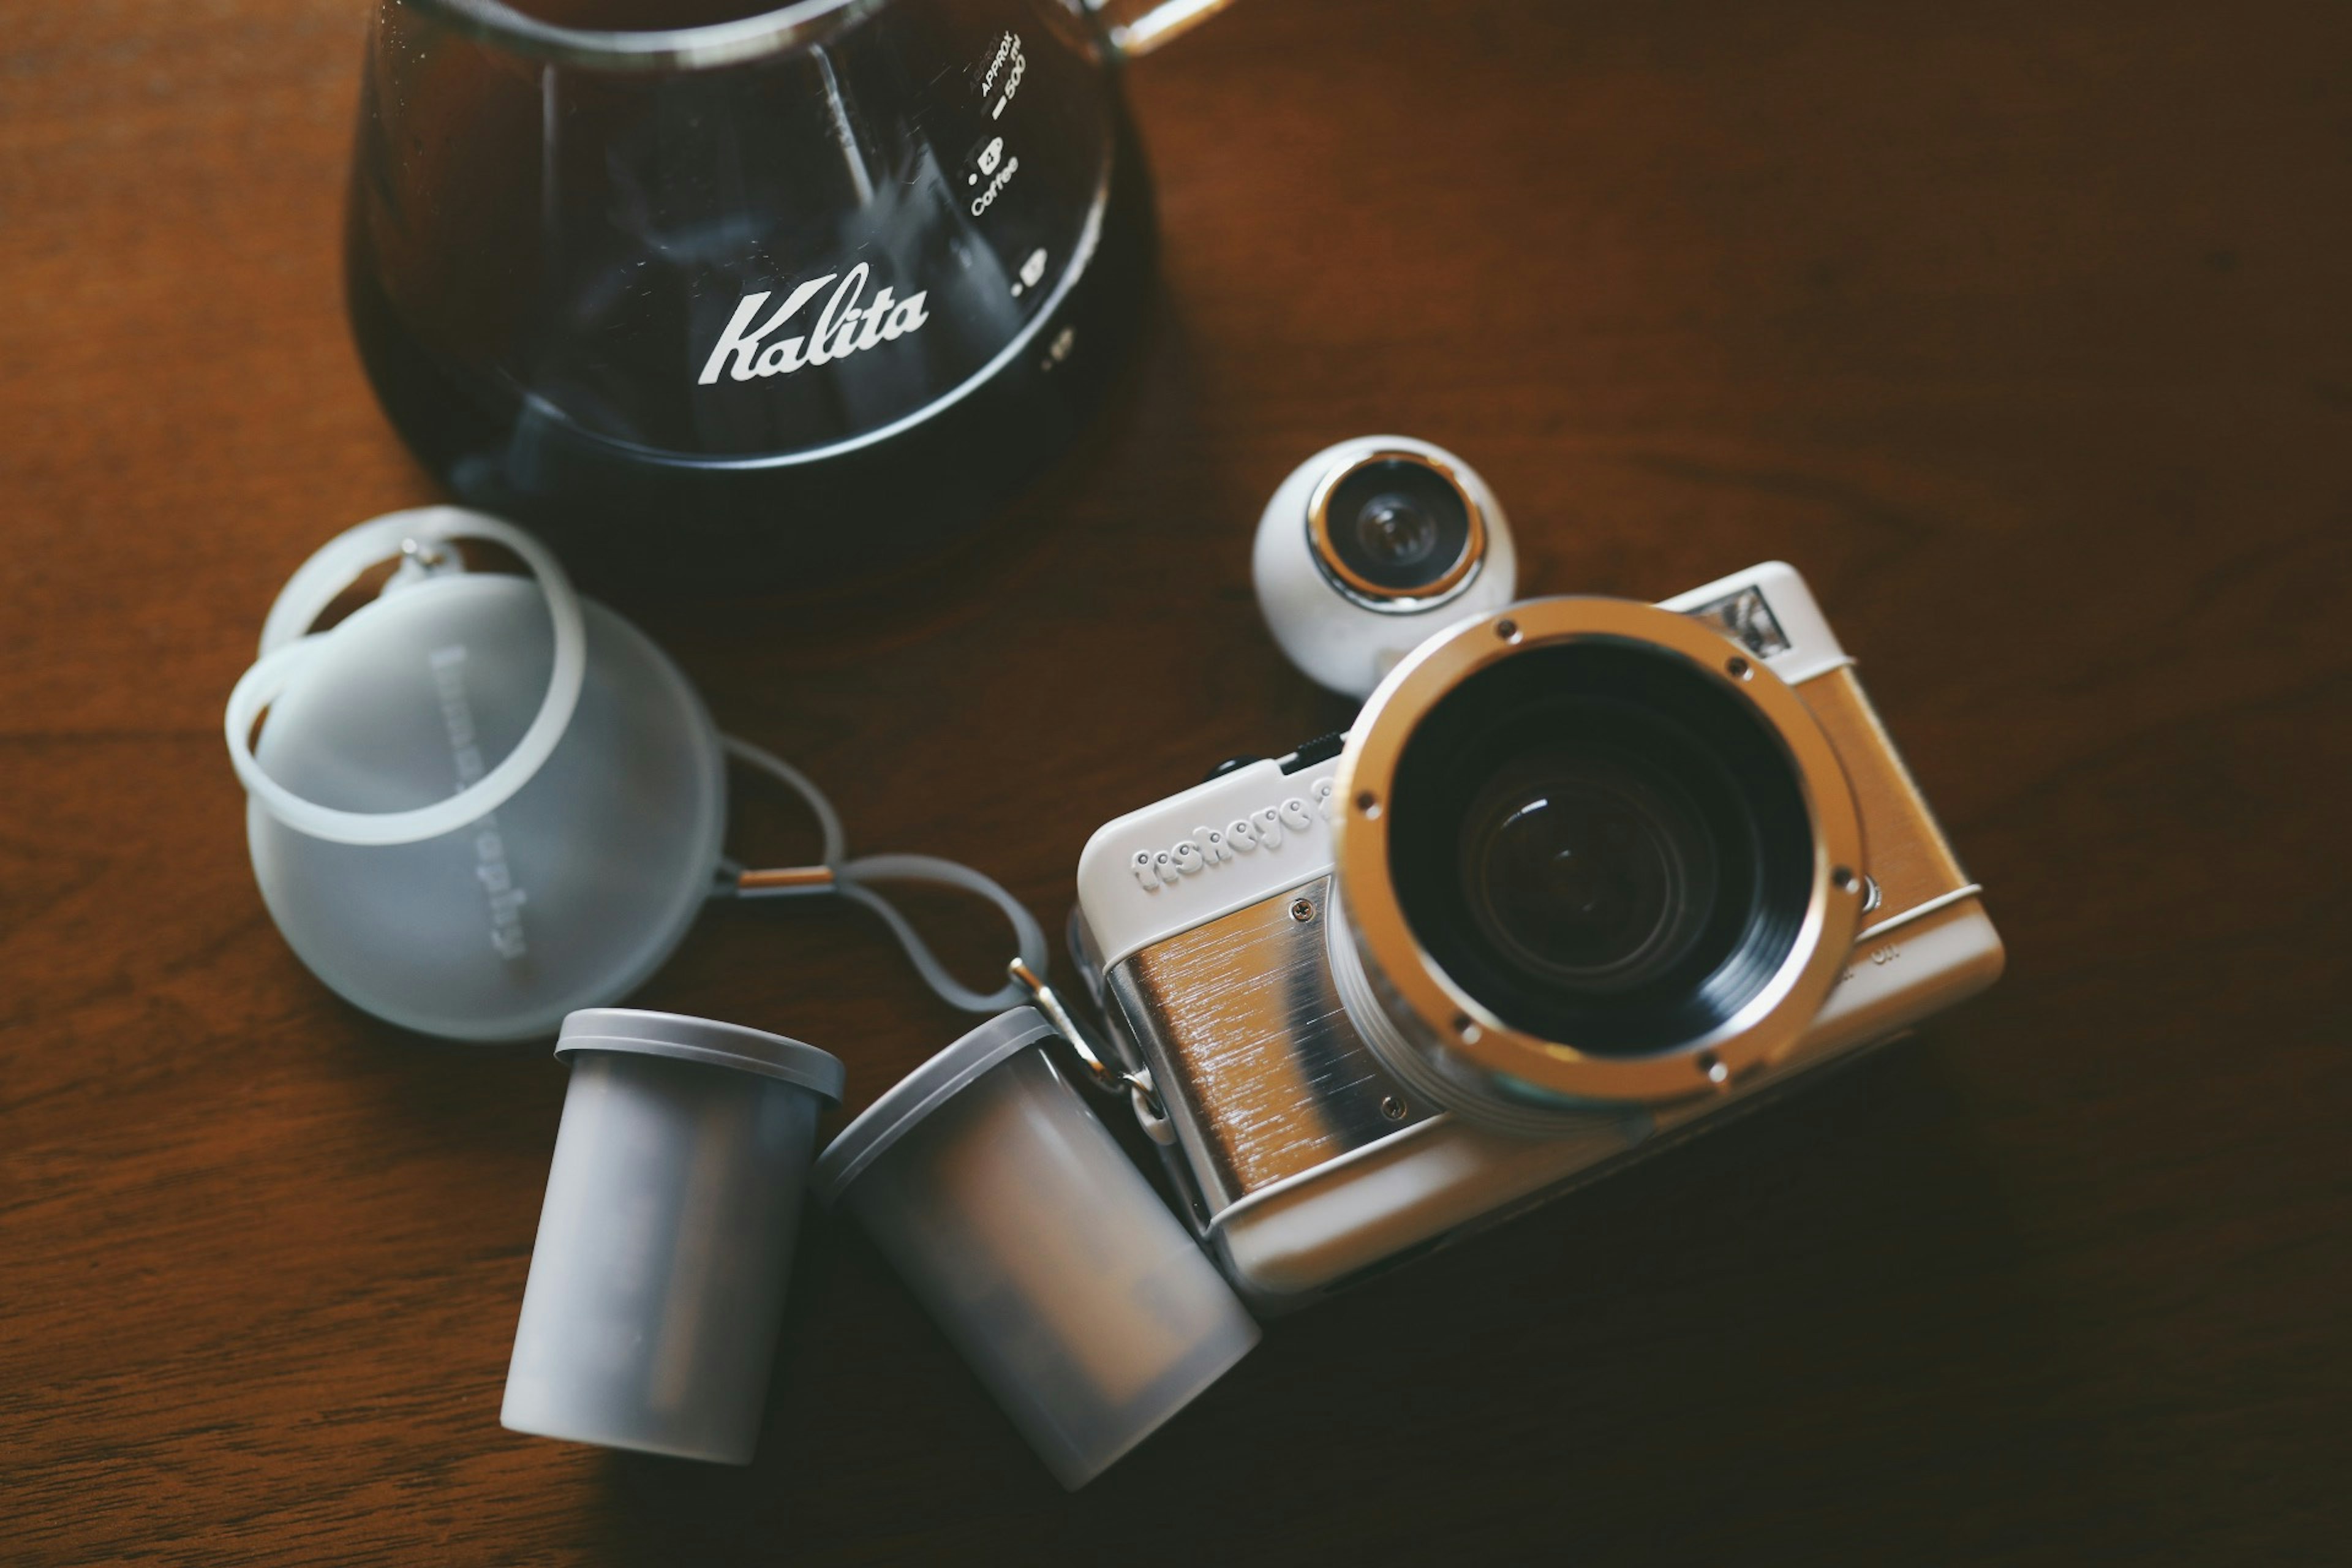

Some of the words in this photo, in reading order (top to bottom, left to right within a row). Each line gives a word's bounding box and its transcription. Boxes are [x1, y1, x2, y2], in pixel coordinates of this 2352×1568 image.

[982, 30, 1012, 97] APPROX
[1005, 54, 1026, 100] 500
[971, 156, 1019, 216] Coffee
[698, 262, 930, 385] Kalita
